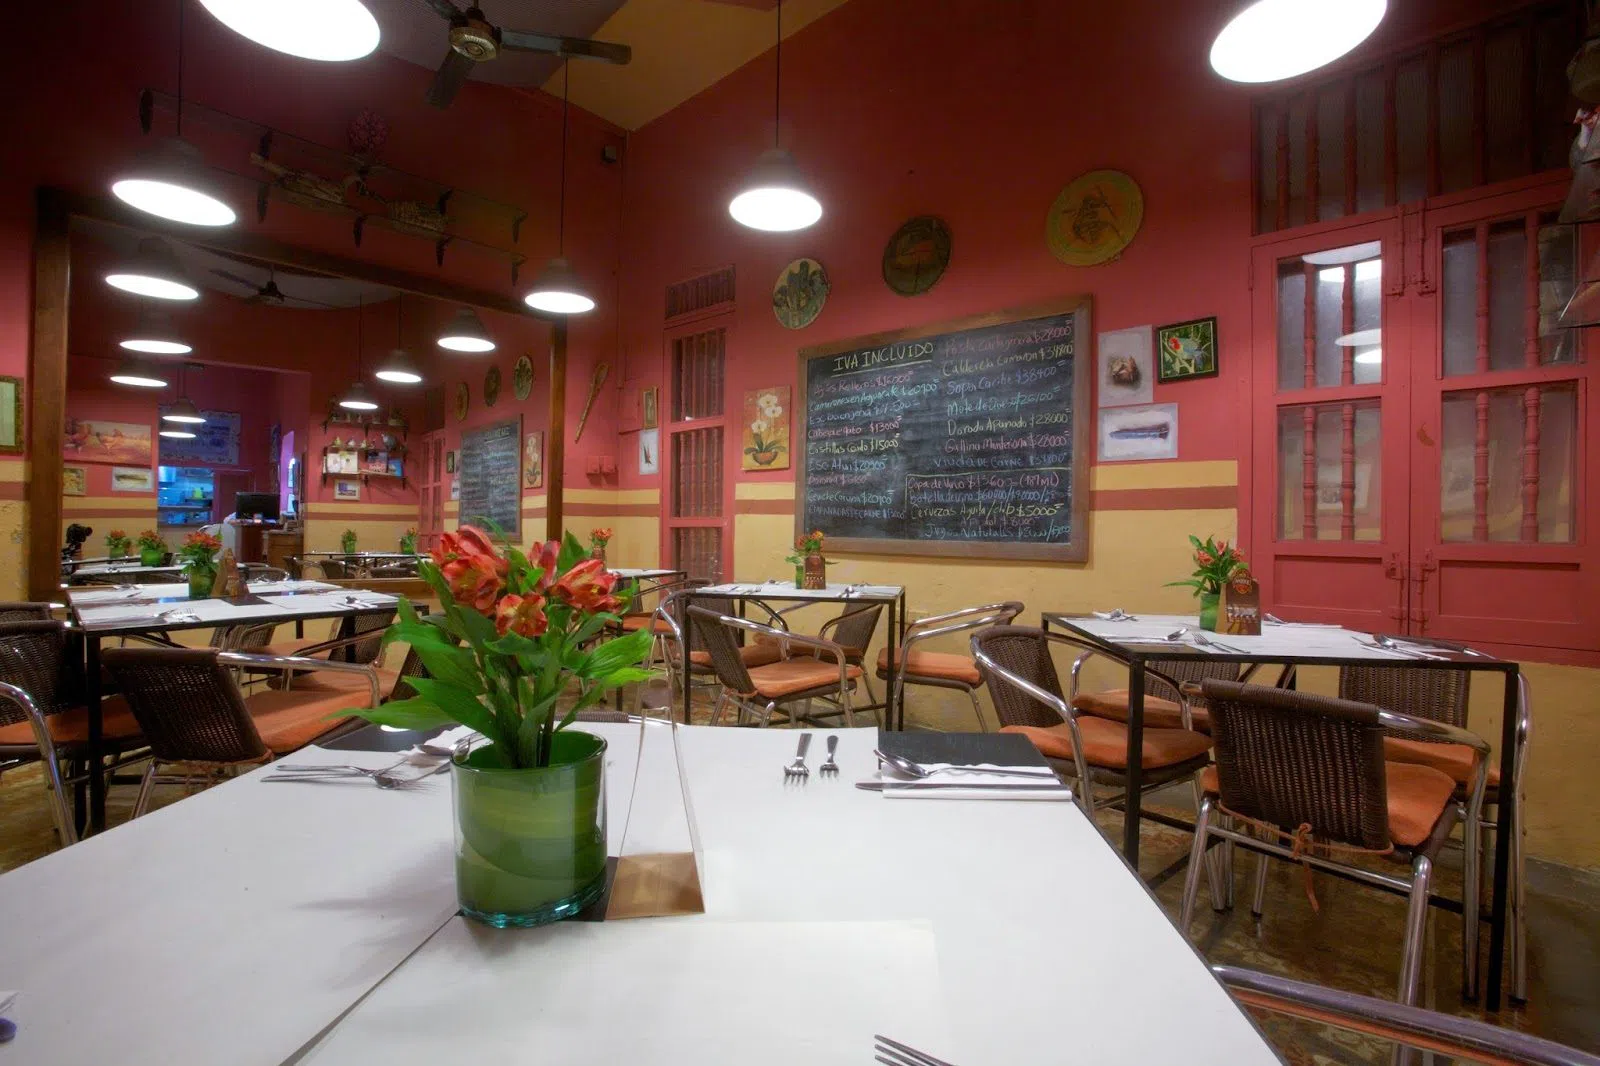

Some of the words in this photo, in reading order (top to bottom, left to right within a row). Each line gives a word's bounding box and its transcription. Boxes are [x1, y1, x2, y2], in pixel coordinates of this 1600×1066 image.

[832, 353, 859, 372] IVA
[861, 342, 934, 368] INCLUIDO
[946, 380, 977, 399] Sopa
